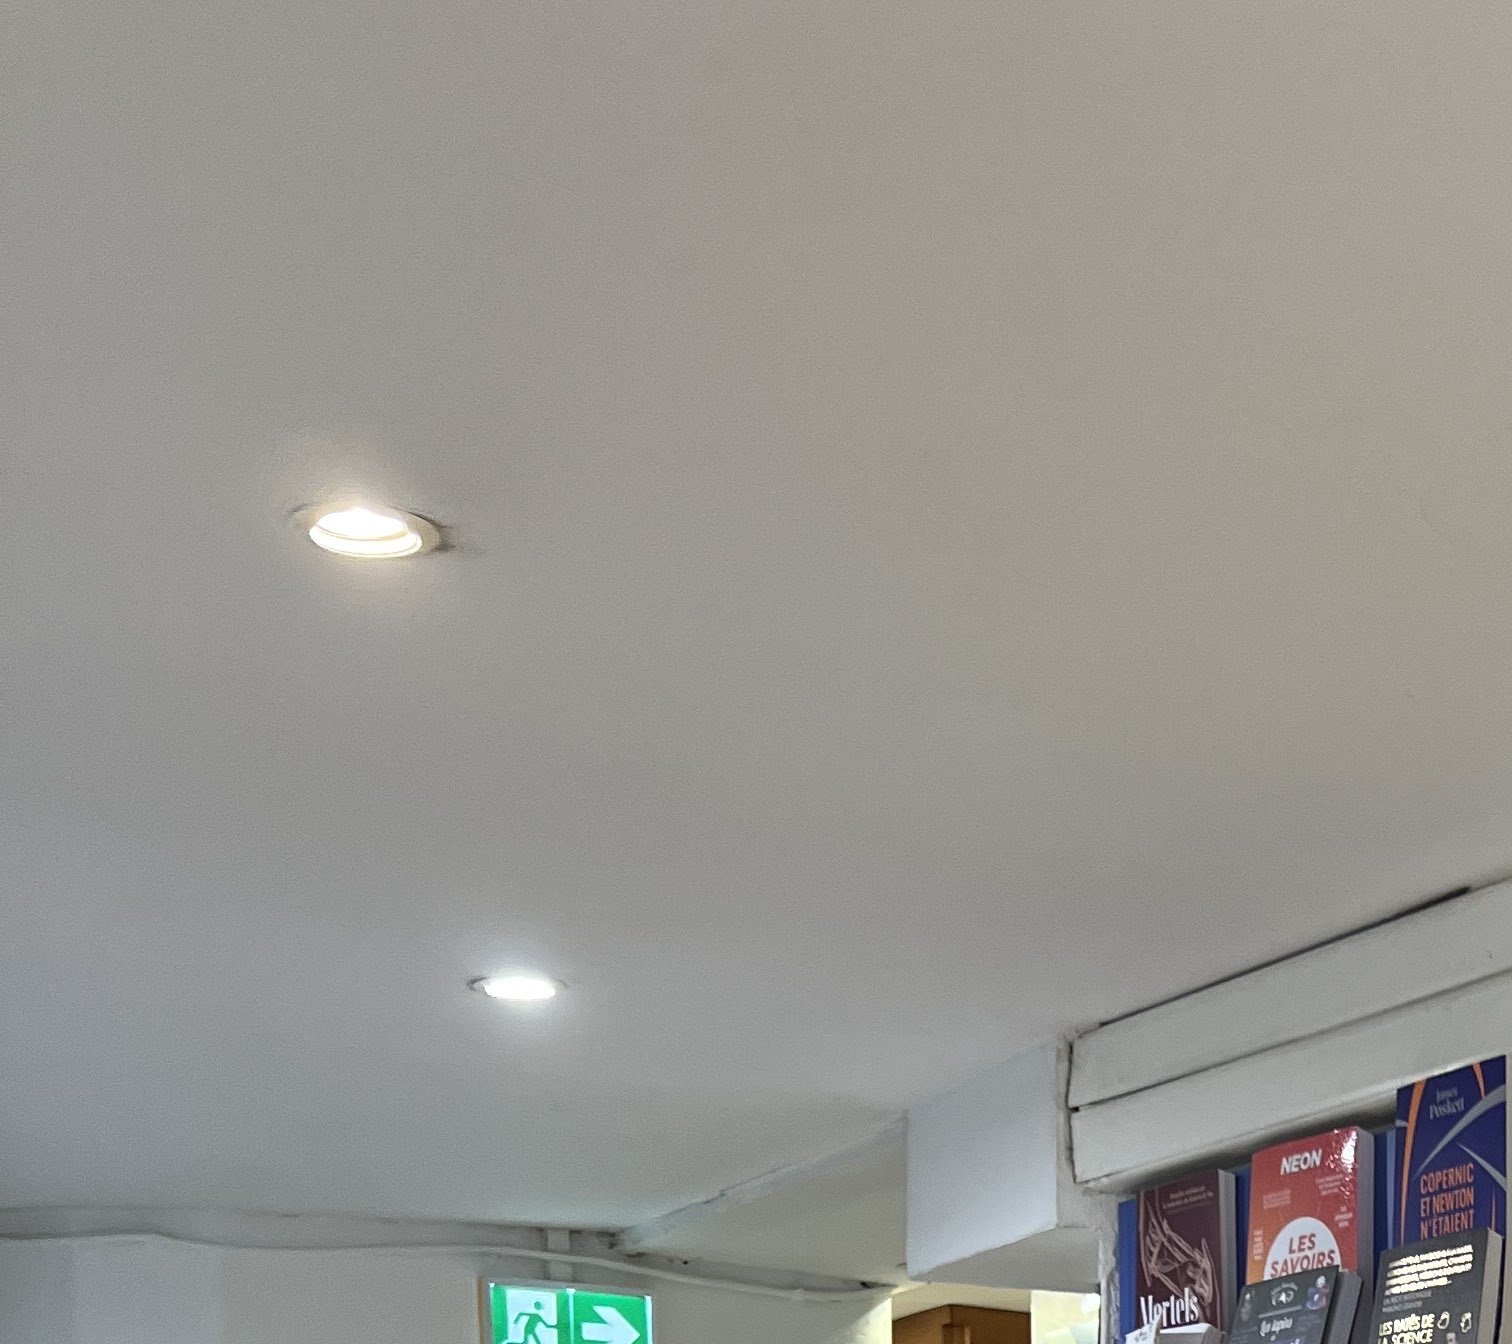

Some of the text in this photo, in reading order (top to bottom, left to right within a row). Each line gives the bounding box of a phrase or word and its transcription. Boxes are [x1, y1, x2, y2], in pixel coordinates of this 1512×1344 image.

[1280, 1149, 1322, 1175] NEON
[1420, 1163, 1474, 1194] COPERNIC
[1420, 1186, 1474, 1217] ET NEWTON
[1288, 1233, 1316, 1255] LES
[1271, 1250, 1335, 1278] SAVOIRS
